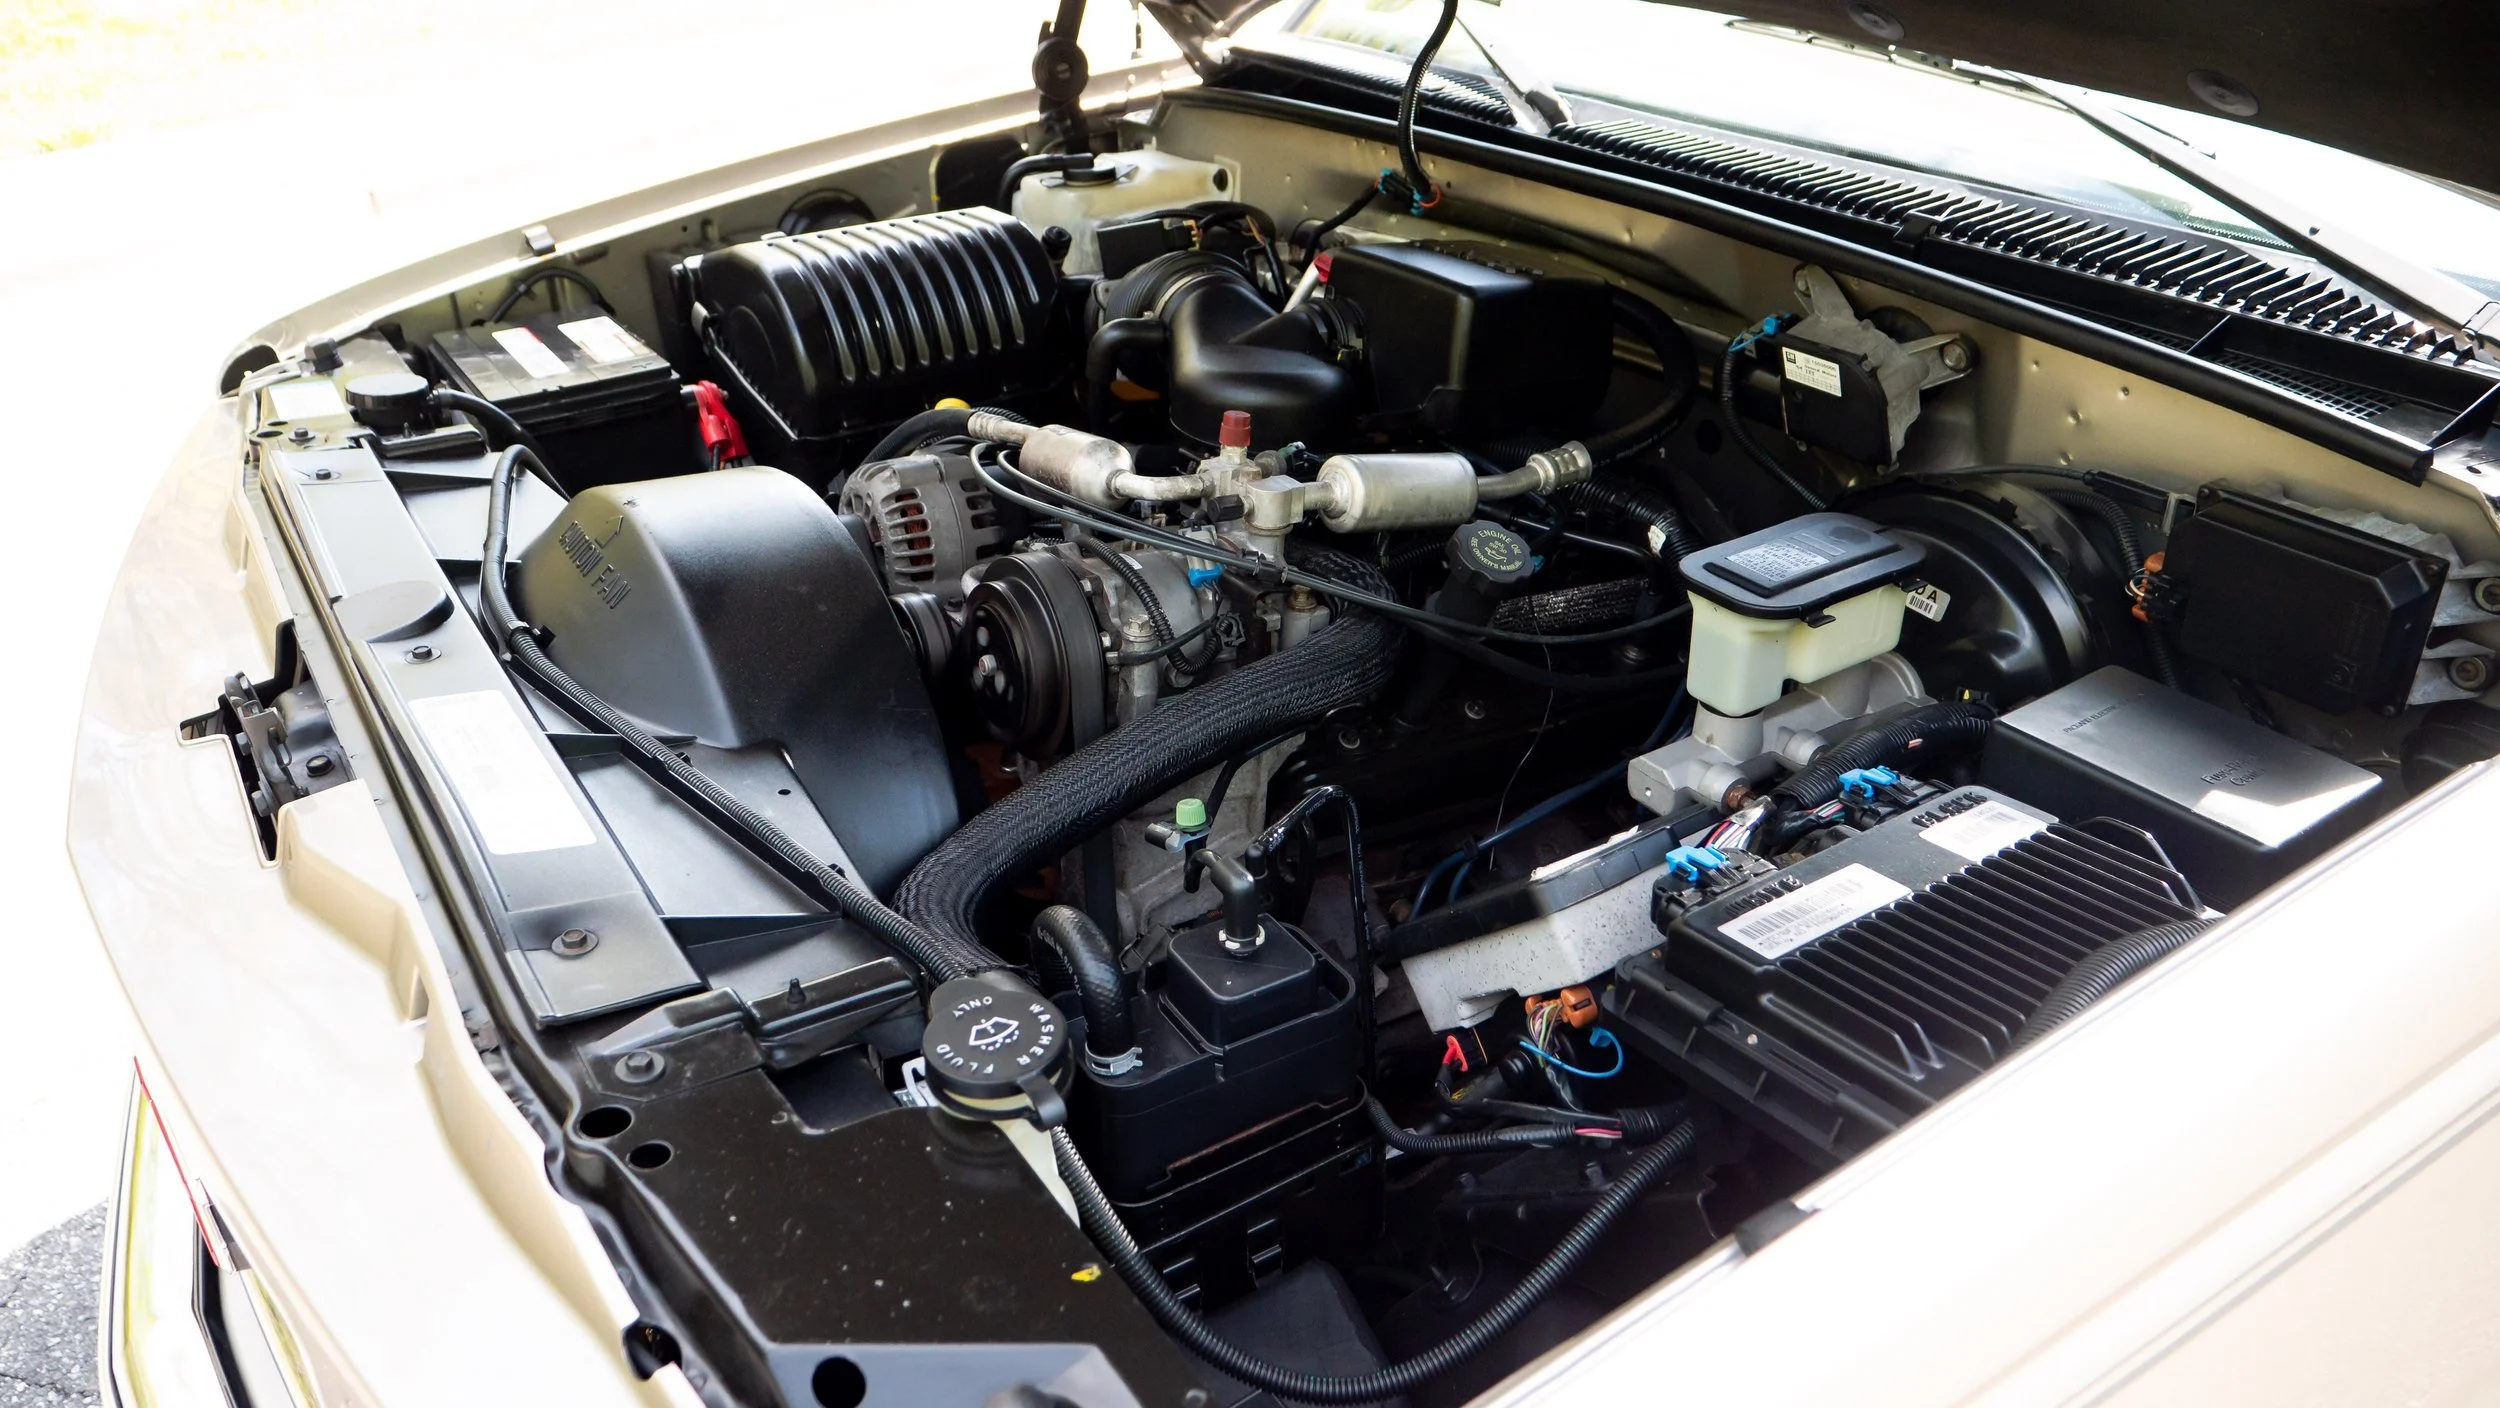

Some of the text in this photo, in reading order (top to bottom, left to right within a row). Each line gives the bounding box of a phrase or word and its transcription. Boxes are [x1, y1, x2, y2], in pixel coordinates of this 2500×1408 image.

[559, 520, 632, 610] CAUTION FAN
[1470, 536, 1523, 571] SEE OWNER'S MANUAL
[1477, 529, 1522, 555] ENGINE OIL
[936, 995, 1055, 1074] WASHER FLUID ONLY
